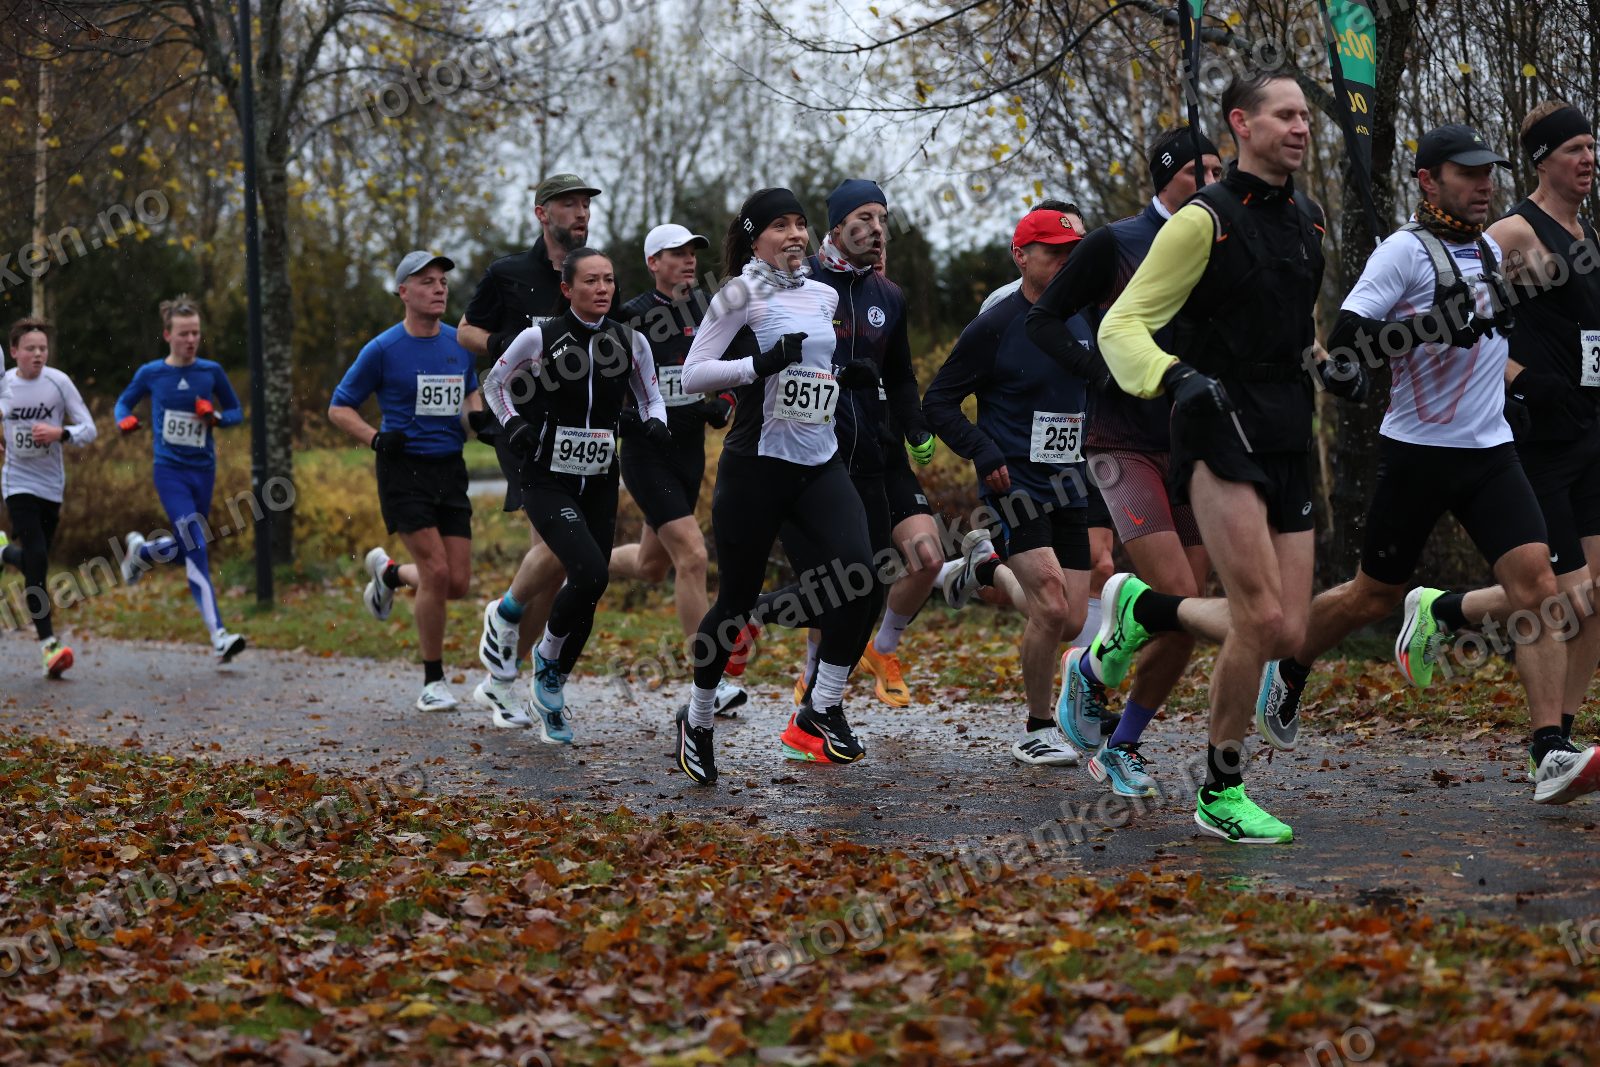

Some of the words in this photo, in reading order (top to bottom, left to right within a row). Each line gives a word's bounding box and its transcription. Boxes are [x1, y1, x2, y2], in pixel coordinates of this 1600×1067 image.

[785, 369, 836, 381] NORGESTESTEN
[422, 386, 461, 405] 9513
[783, 380, 834, 411] 9517
[167, 418, 203, 438] 9514
[561, 430, 611, 438] NORGESTESTEN
[1044, 426, 1080, 452] 255
[559, 439, 610, 463] 9495
